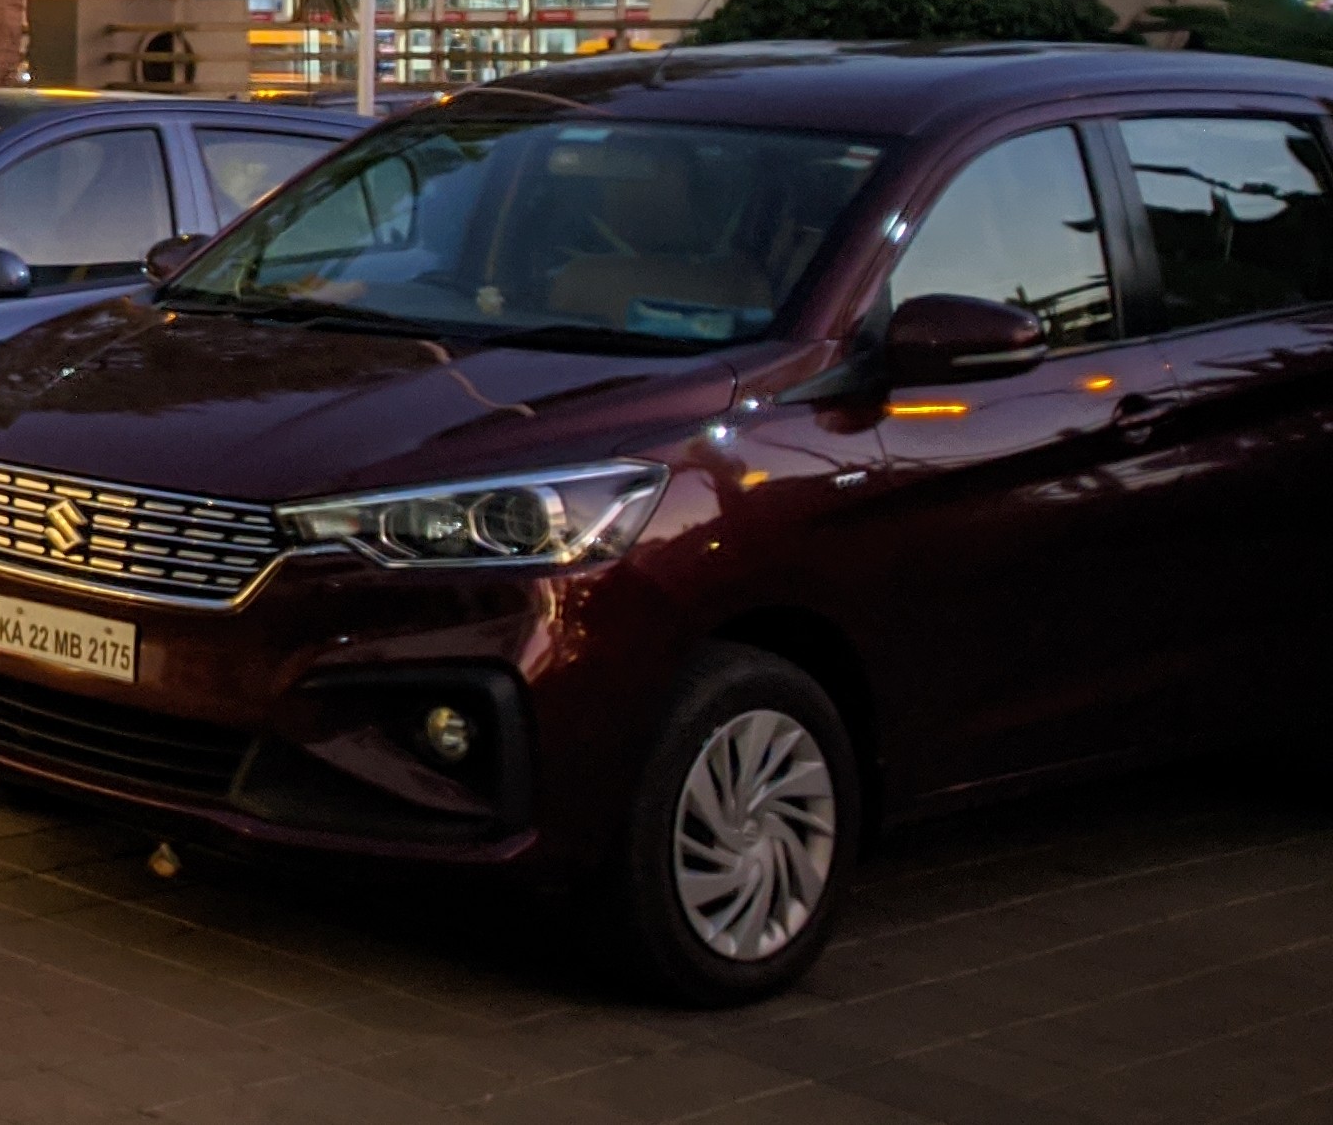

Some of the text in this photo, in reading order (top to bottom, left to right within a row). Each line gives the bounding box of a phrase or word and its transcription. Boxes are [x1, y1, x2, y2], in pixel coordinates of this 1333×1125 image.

[28, 623, 49, 652] 22
[54, 629, 83, 659] MB
[88, 636, 131, 671] 2175
